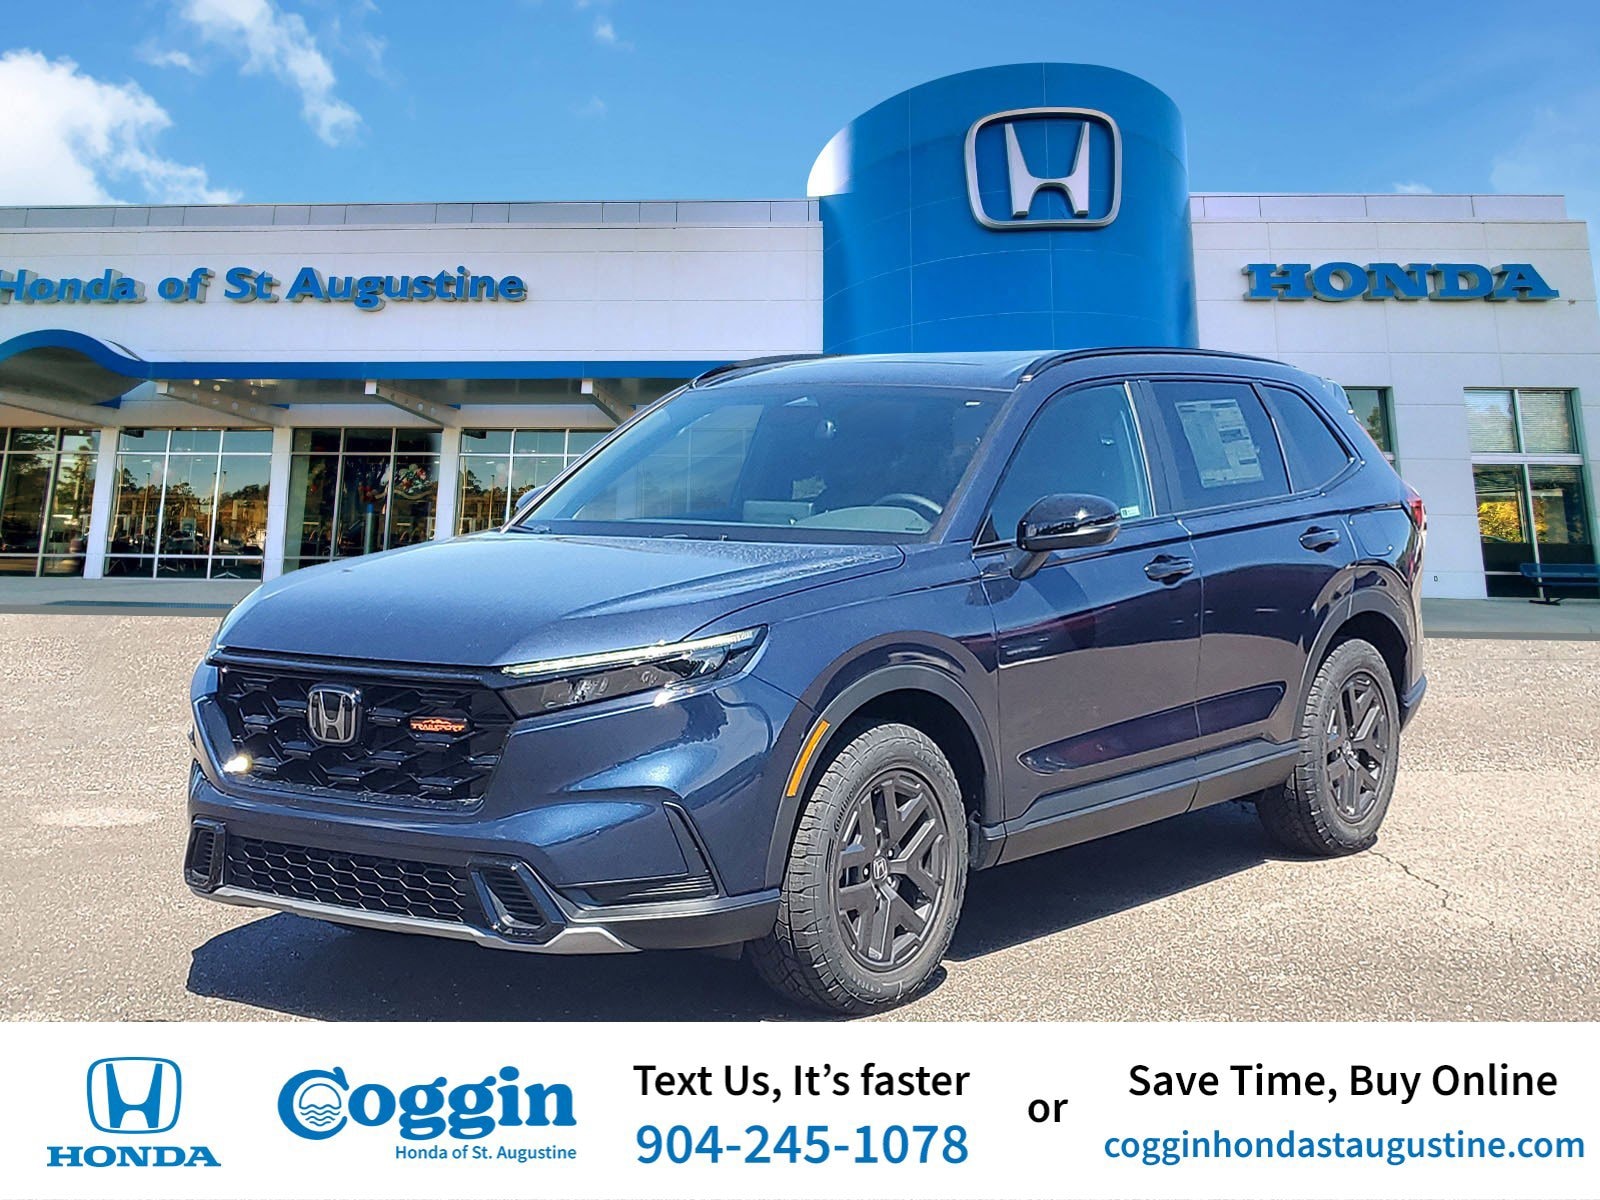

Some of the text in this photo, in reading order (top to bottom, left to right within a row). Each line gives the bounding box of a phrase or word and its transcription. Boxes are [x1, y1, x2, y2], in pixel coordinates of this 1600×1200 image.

[0, 264, 528, 311] Honda of St Augustine
[1241, 260, 1560, 301] HONDA
